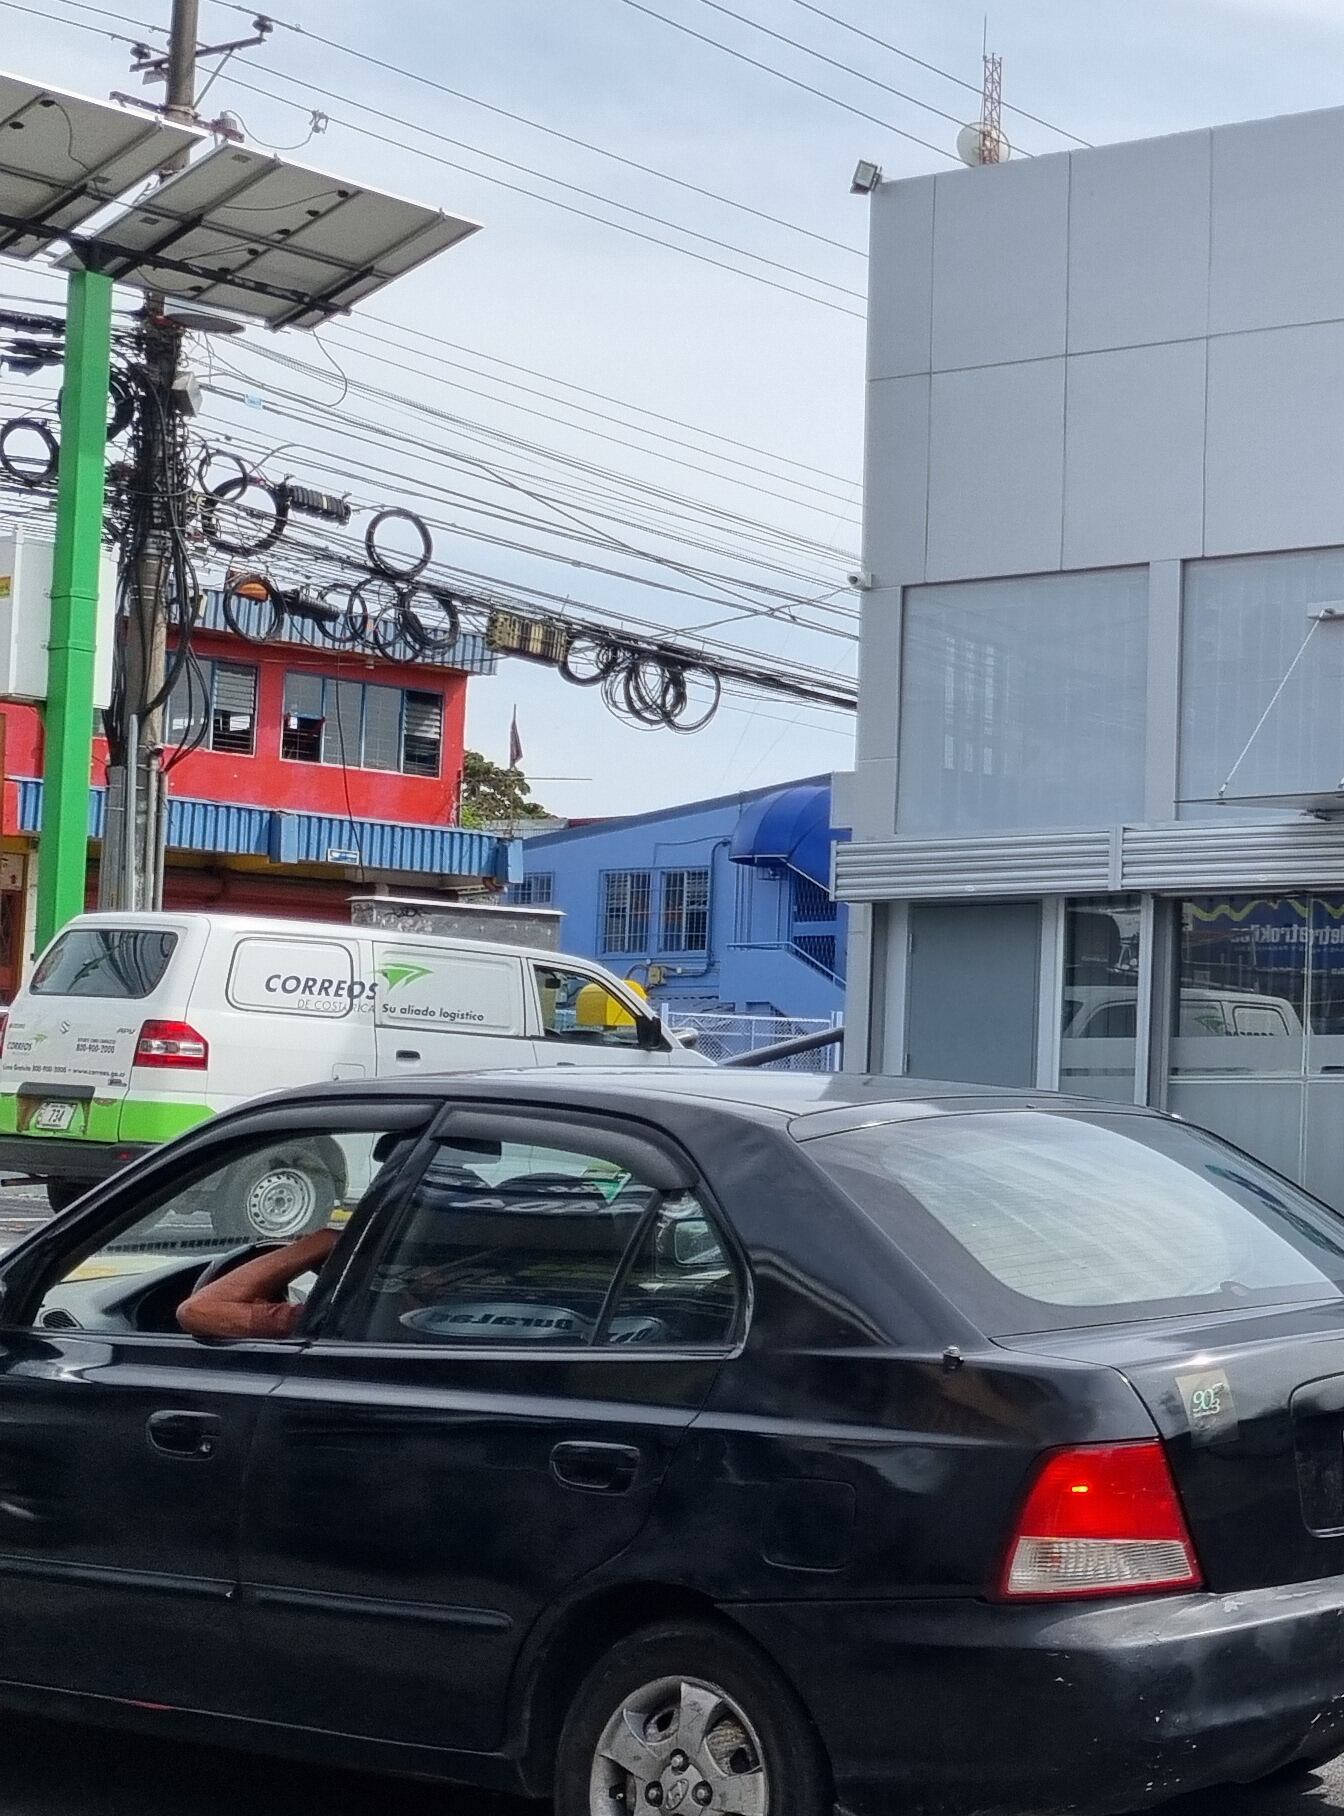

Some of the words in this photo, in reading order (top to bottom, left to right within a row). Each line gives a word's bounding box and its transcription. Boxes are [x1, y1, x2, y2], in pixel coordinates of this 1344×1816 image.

[264, 974, 379, 1001] CORREOS
[297, 999, 311, 1009] DE
[314, 1000, 348, 1012] COSTA
[352, 1003, 376, 1014] RICA
[382, 1003, 397, 1014] Su
[399, 1004, 436, 1017] aliado
[7, 1041, 33, 1052] CORREOS
